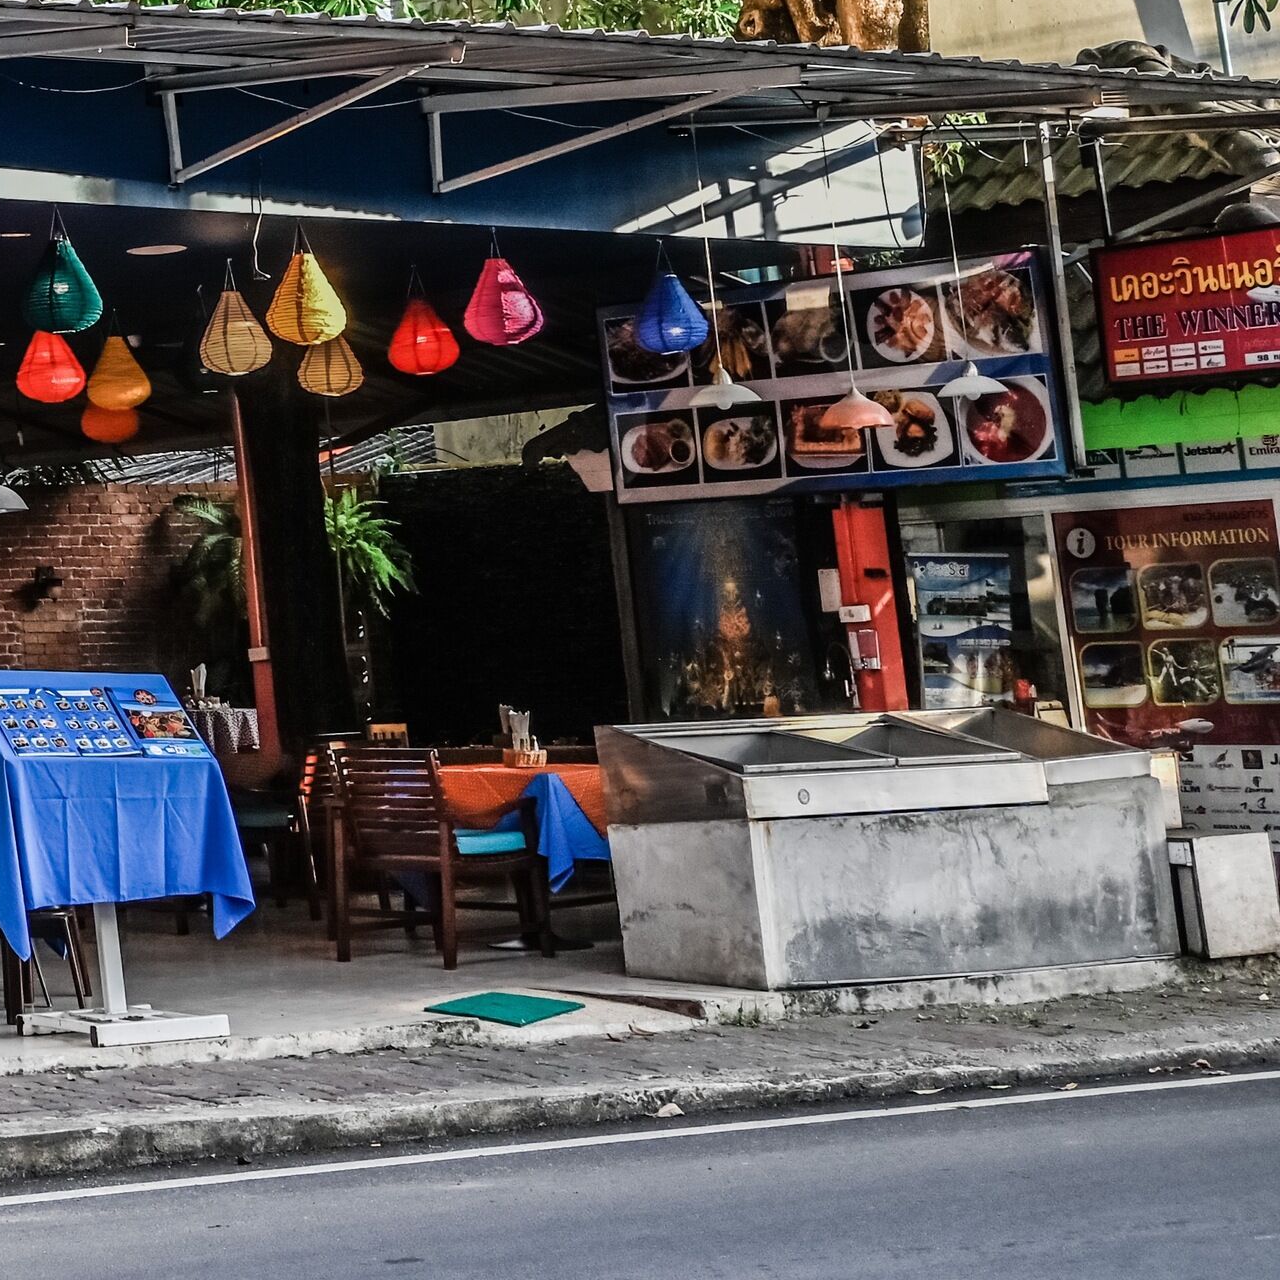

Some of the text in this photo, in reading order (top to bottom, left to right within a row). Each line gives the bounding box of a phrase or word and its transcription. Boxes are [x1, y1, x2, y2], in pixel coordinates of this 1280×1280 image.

[1114, 313, 1169, 343] THE
[1183, 445, 1225, 458] Jetstar
[1104, 526, 1271, 551] TOUR INFORMATION
